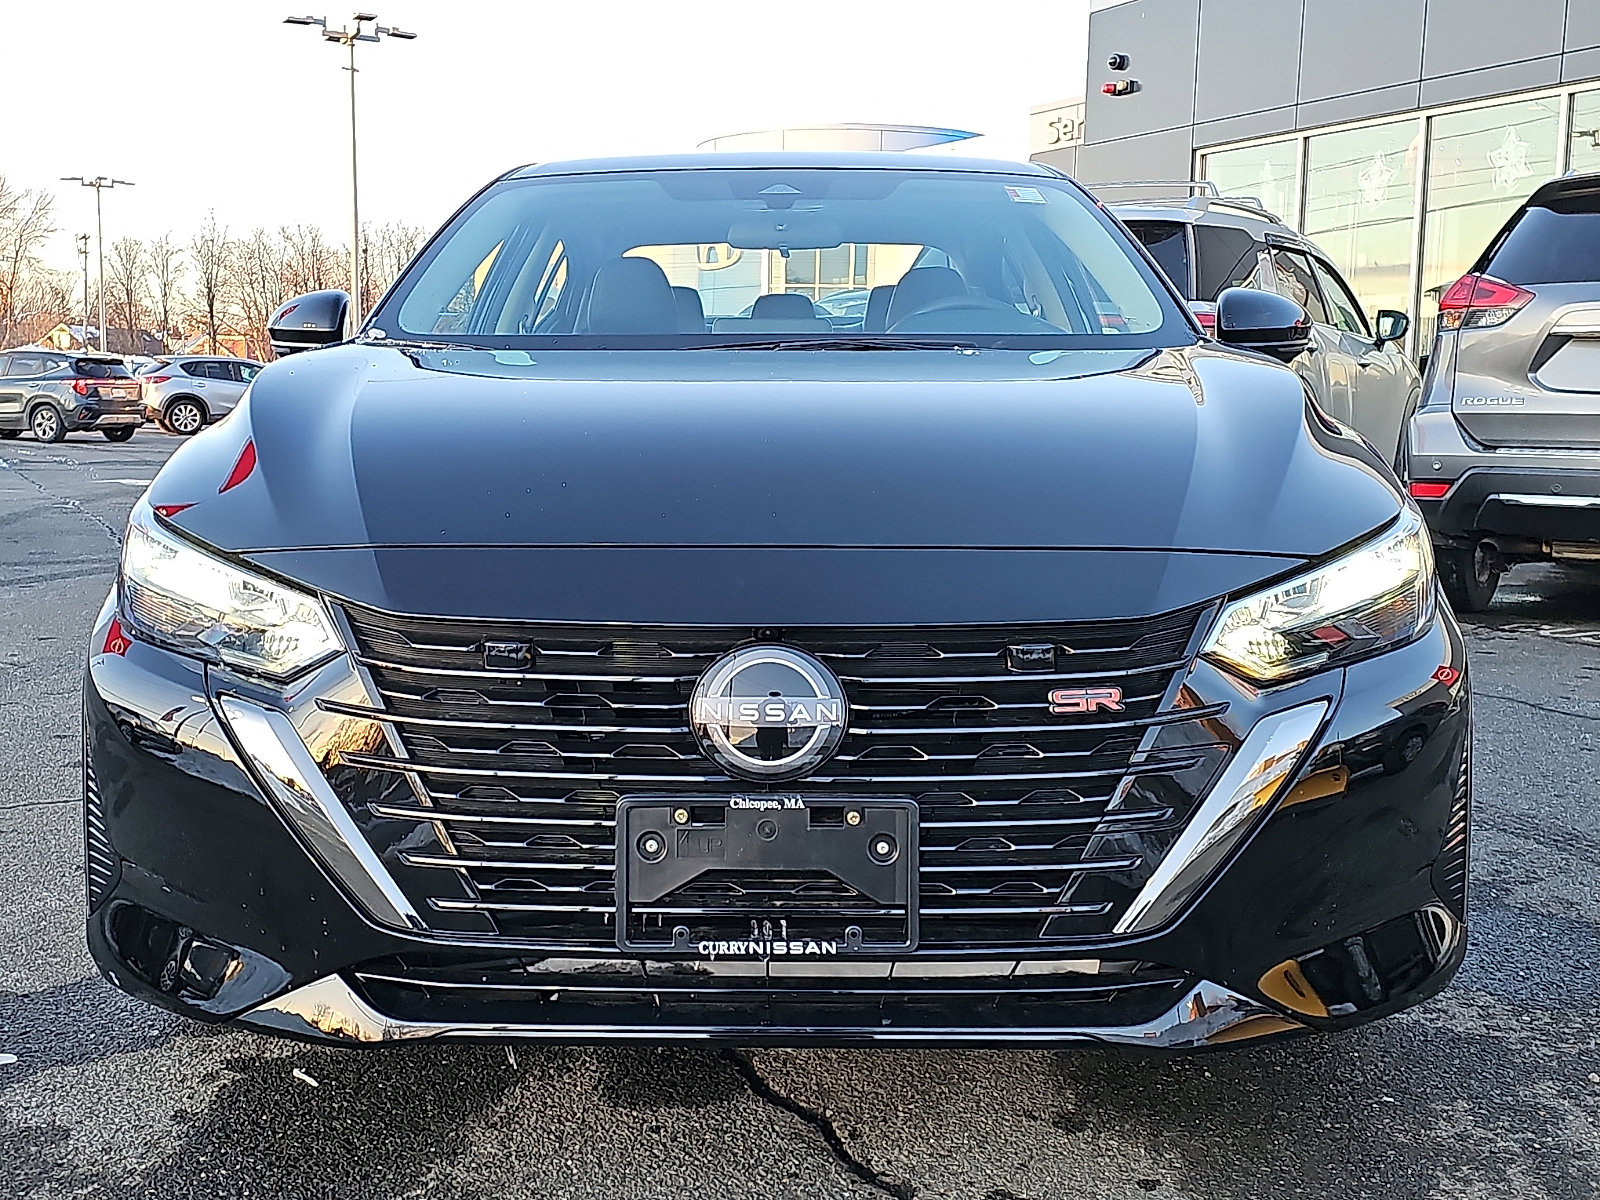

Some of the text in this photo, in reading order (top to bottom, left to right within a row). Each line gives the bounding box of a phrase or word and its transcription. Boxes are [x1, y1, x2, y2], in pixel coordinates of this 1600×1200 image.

[1461, 396, 1526, 406] ROGUE
[1048, 687, 1125, 715] SR
[701, 703, 837, 722] NISSAN
[783, 795, 806, 809] MA
